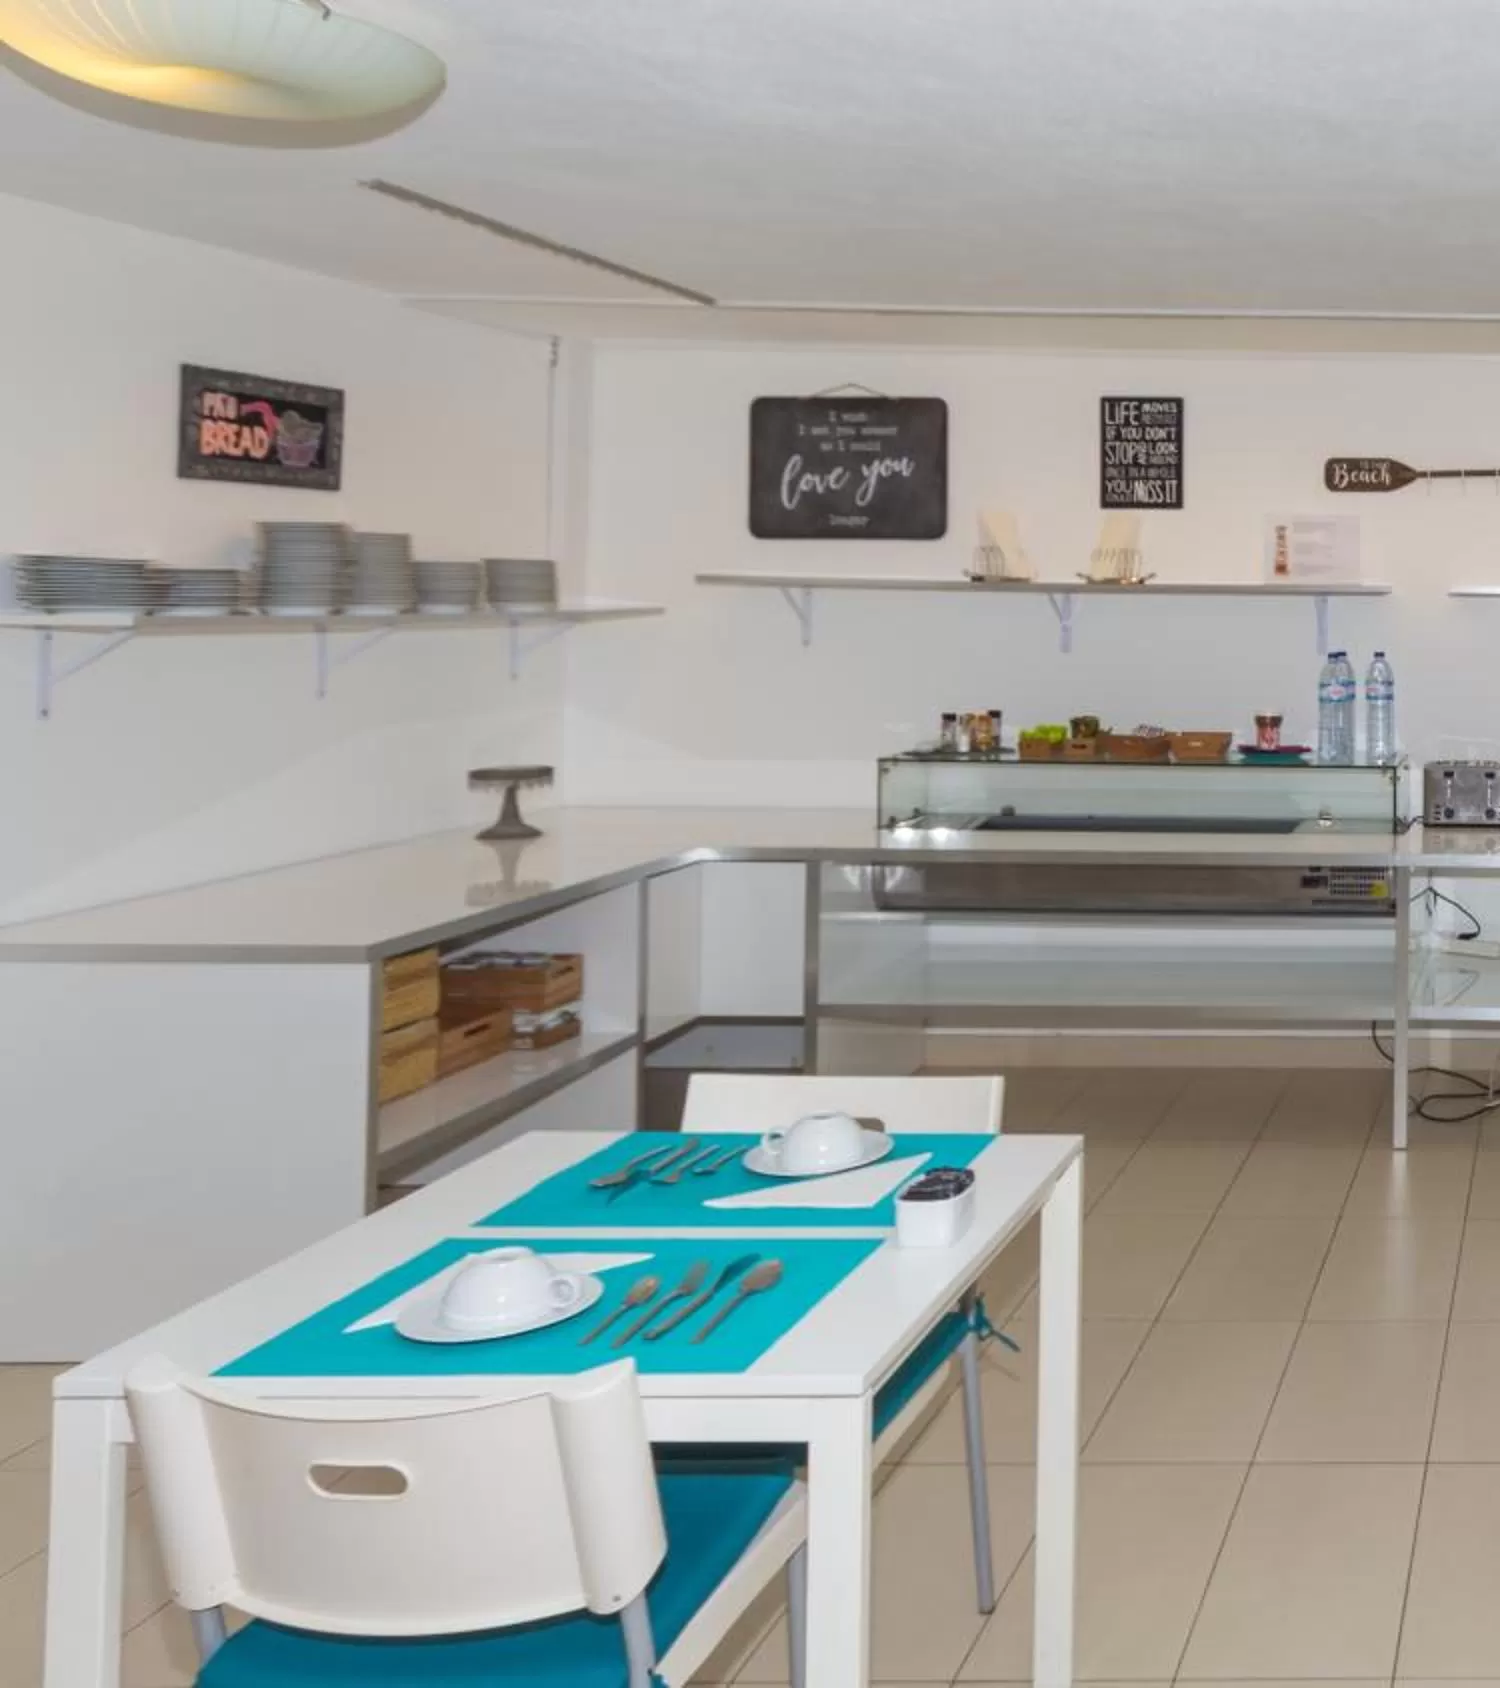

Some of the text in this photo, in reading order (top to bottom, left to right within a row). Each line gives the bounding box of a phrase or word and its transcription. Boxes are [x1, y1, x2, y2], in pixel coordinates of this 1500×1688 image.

[1104, 401, 1140, 425] LIFE
[200, 420, 270, 459] BREAD
[1120, 427, 1142, 440] YOU
[1145, 427, 1176, 440] DON'T
[1104, 441, 1136, 464] STOP
[1149, 442, 1179, 454] LOOK
[781, 453, 916, 511] love you
[1332, 463, 1393, 488] Beach
[1105, 479, 1177, 503] YOU MISS IT
